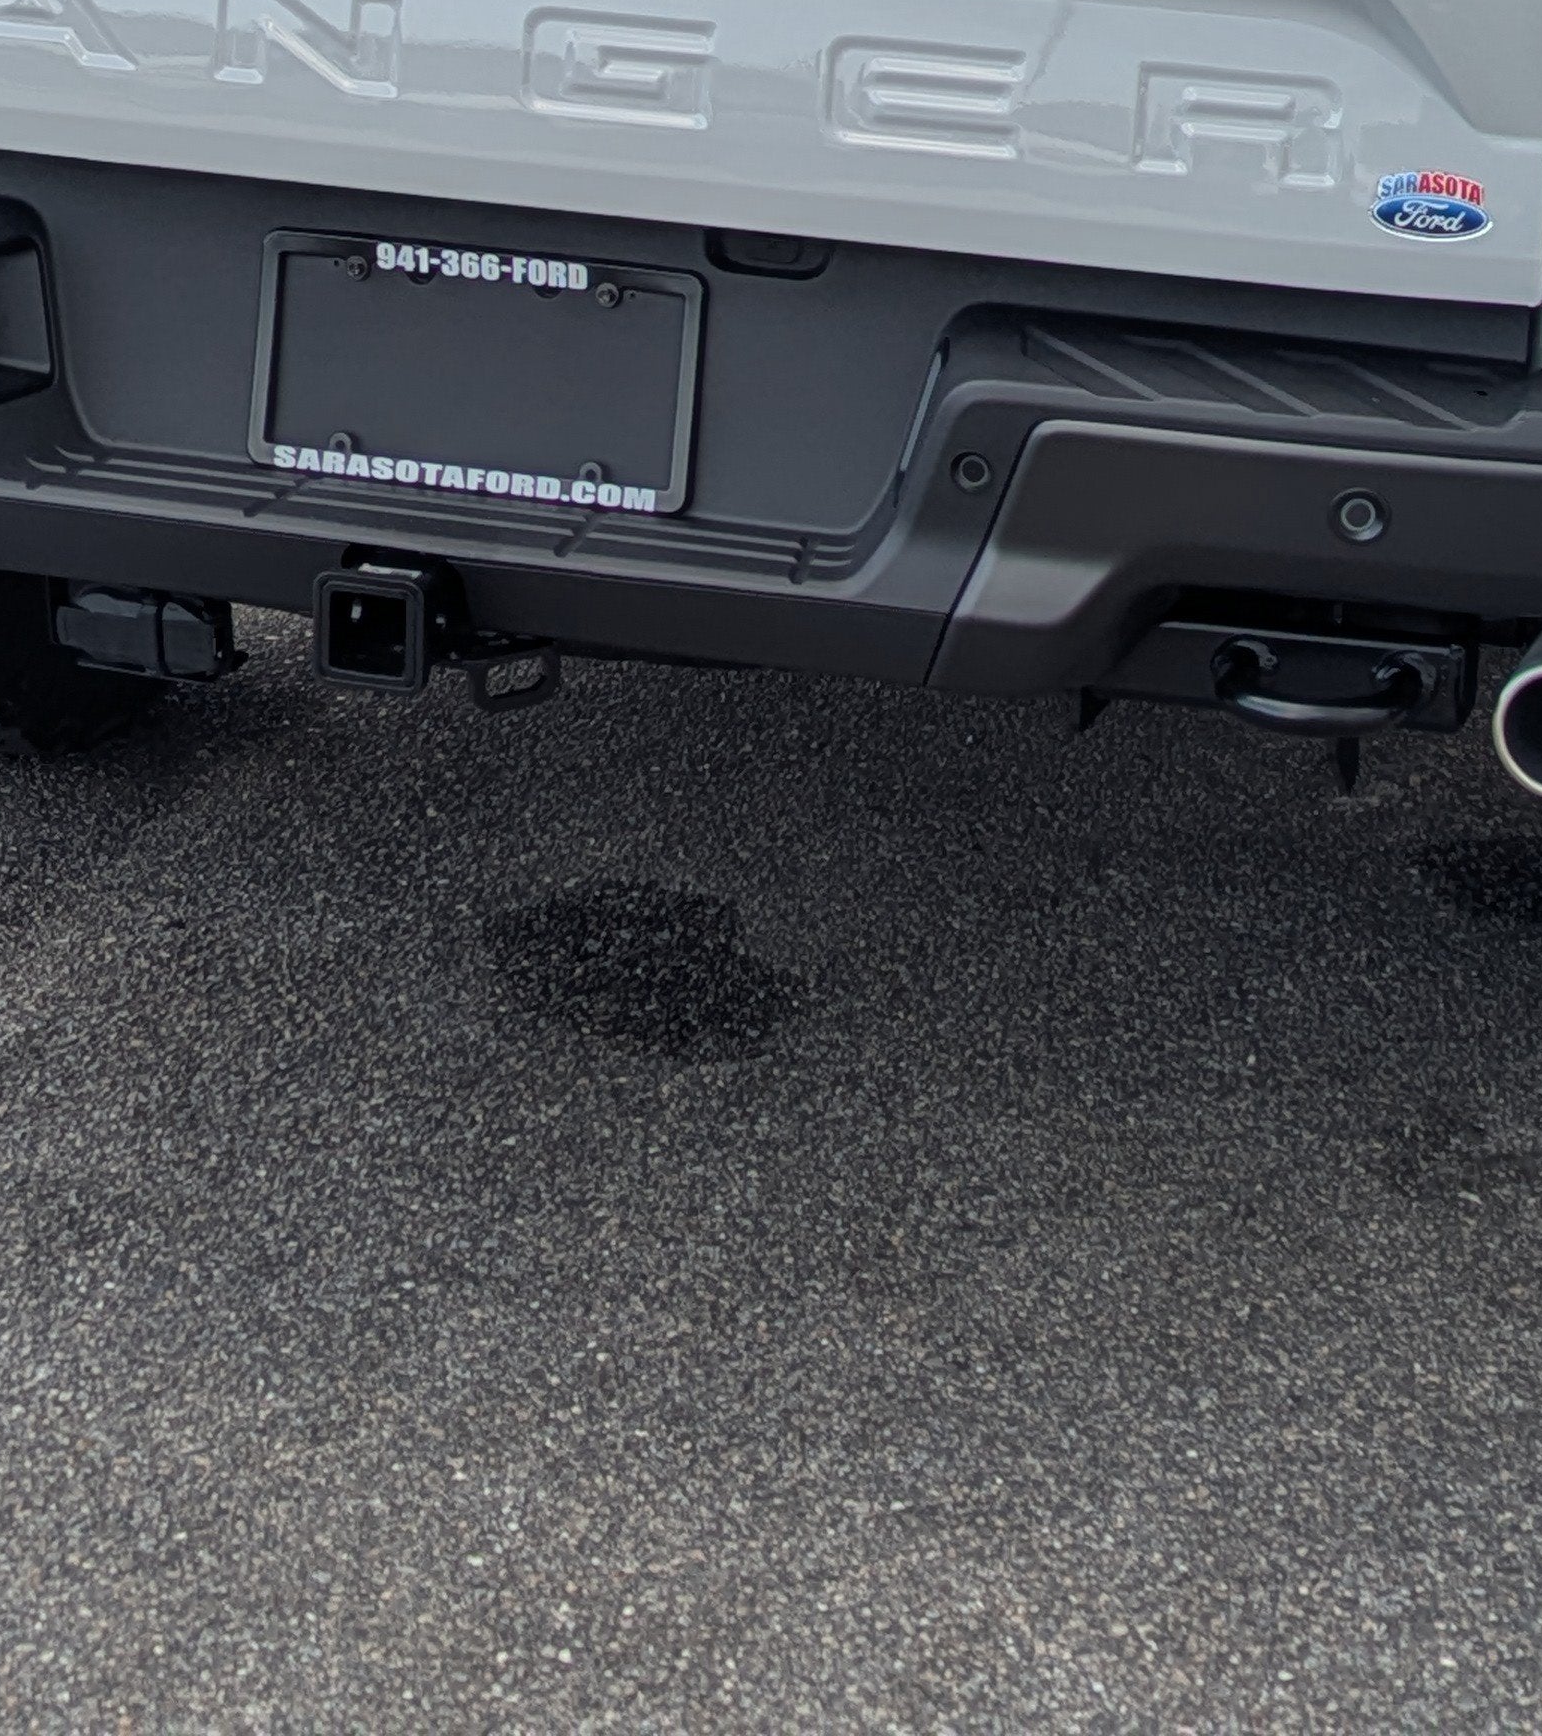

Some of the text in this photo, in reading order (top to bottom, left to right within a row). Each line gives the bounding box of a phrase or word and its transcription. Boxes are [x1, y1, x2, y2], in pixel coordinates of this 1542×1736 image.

[1379, 171, 1485, 206] SARASOTA
[1393, 199, 1466, 233] Ford
[375, 241, 589, 291] 941-366-FORD
[272, 443, 656, 513] SARASOTAFORD.COM
